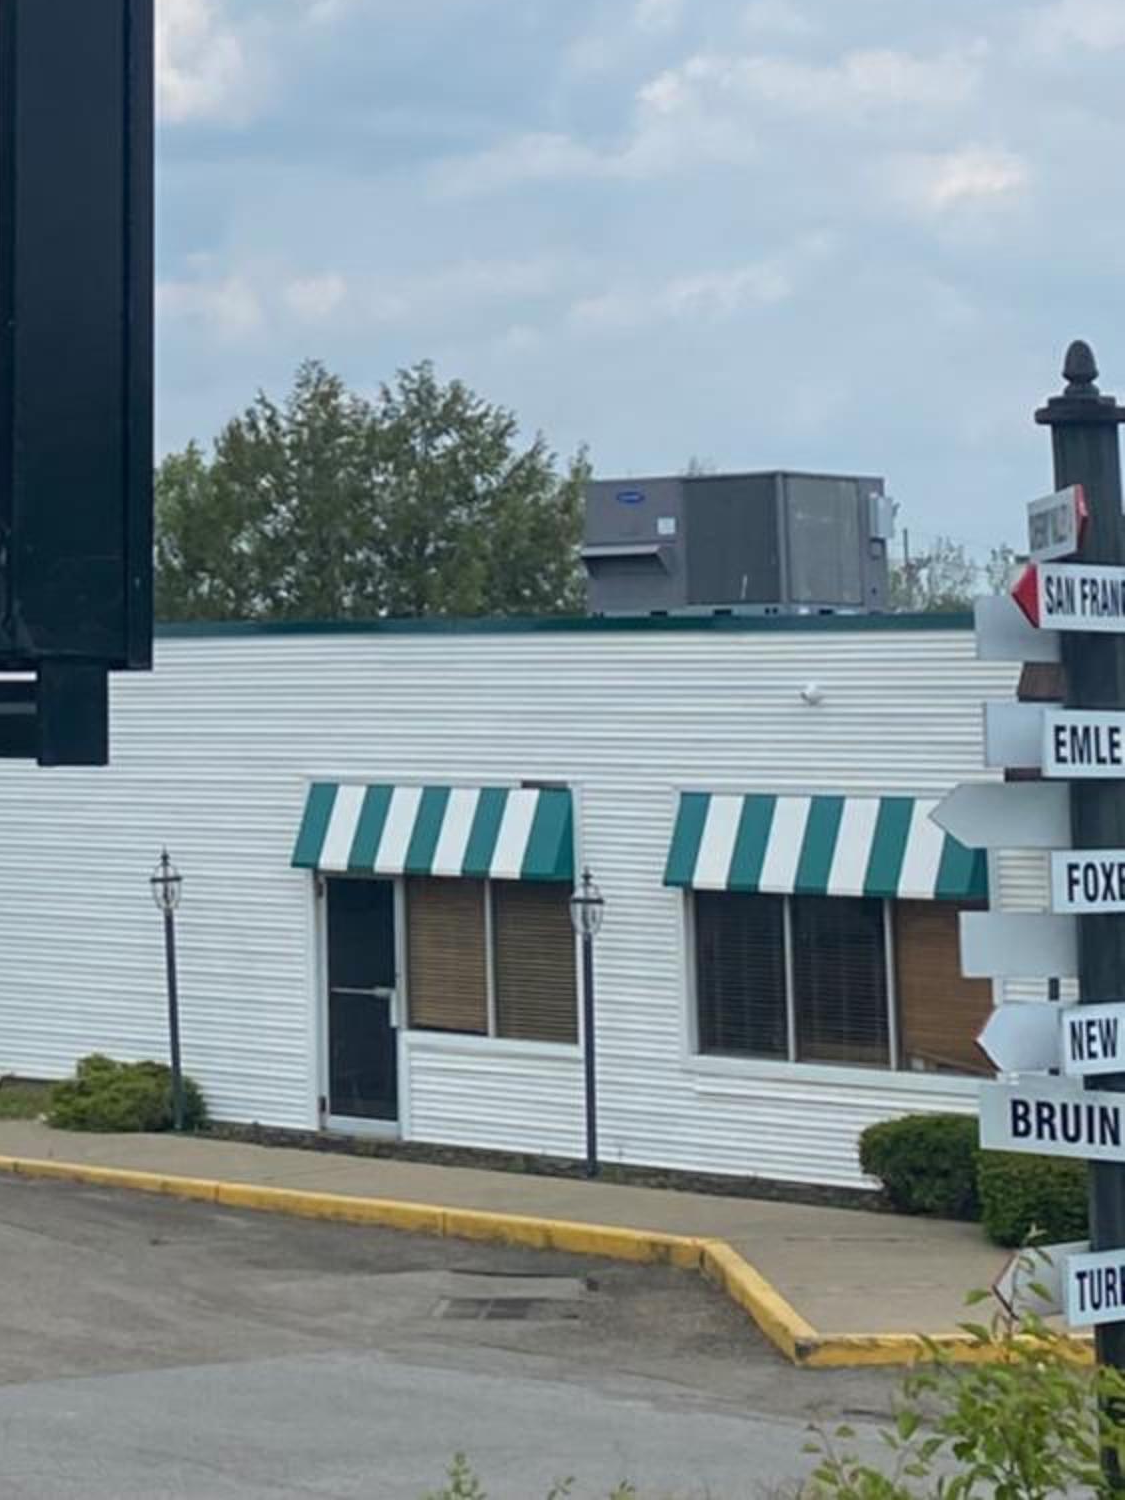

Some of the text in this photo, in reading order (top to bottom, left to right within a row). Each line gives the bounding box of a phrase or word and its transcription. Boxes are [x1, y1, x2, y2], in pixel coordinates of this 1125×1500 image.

[1045, 575, 1076, 615] SAN
[1053, 723, 1122, 765] EMLE
[1069, 1017, 1118, 1061] NEW
[1010, 1098, 1121, 1147] BRUIN
